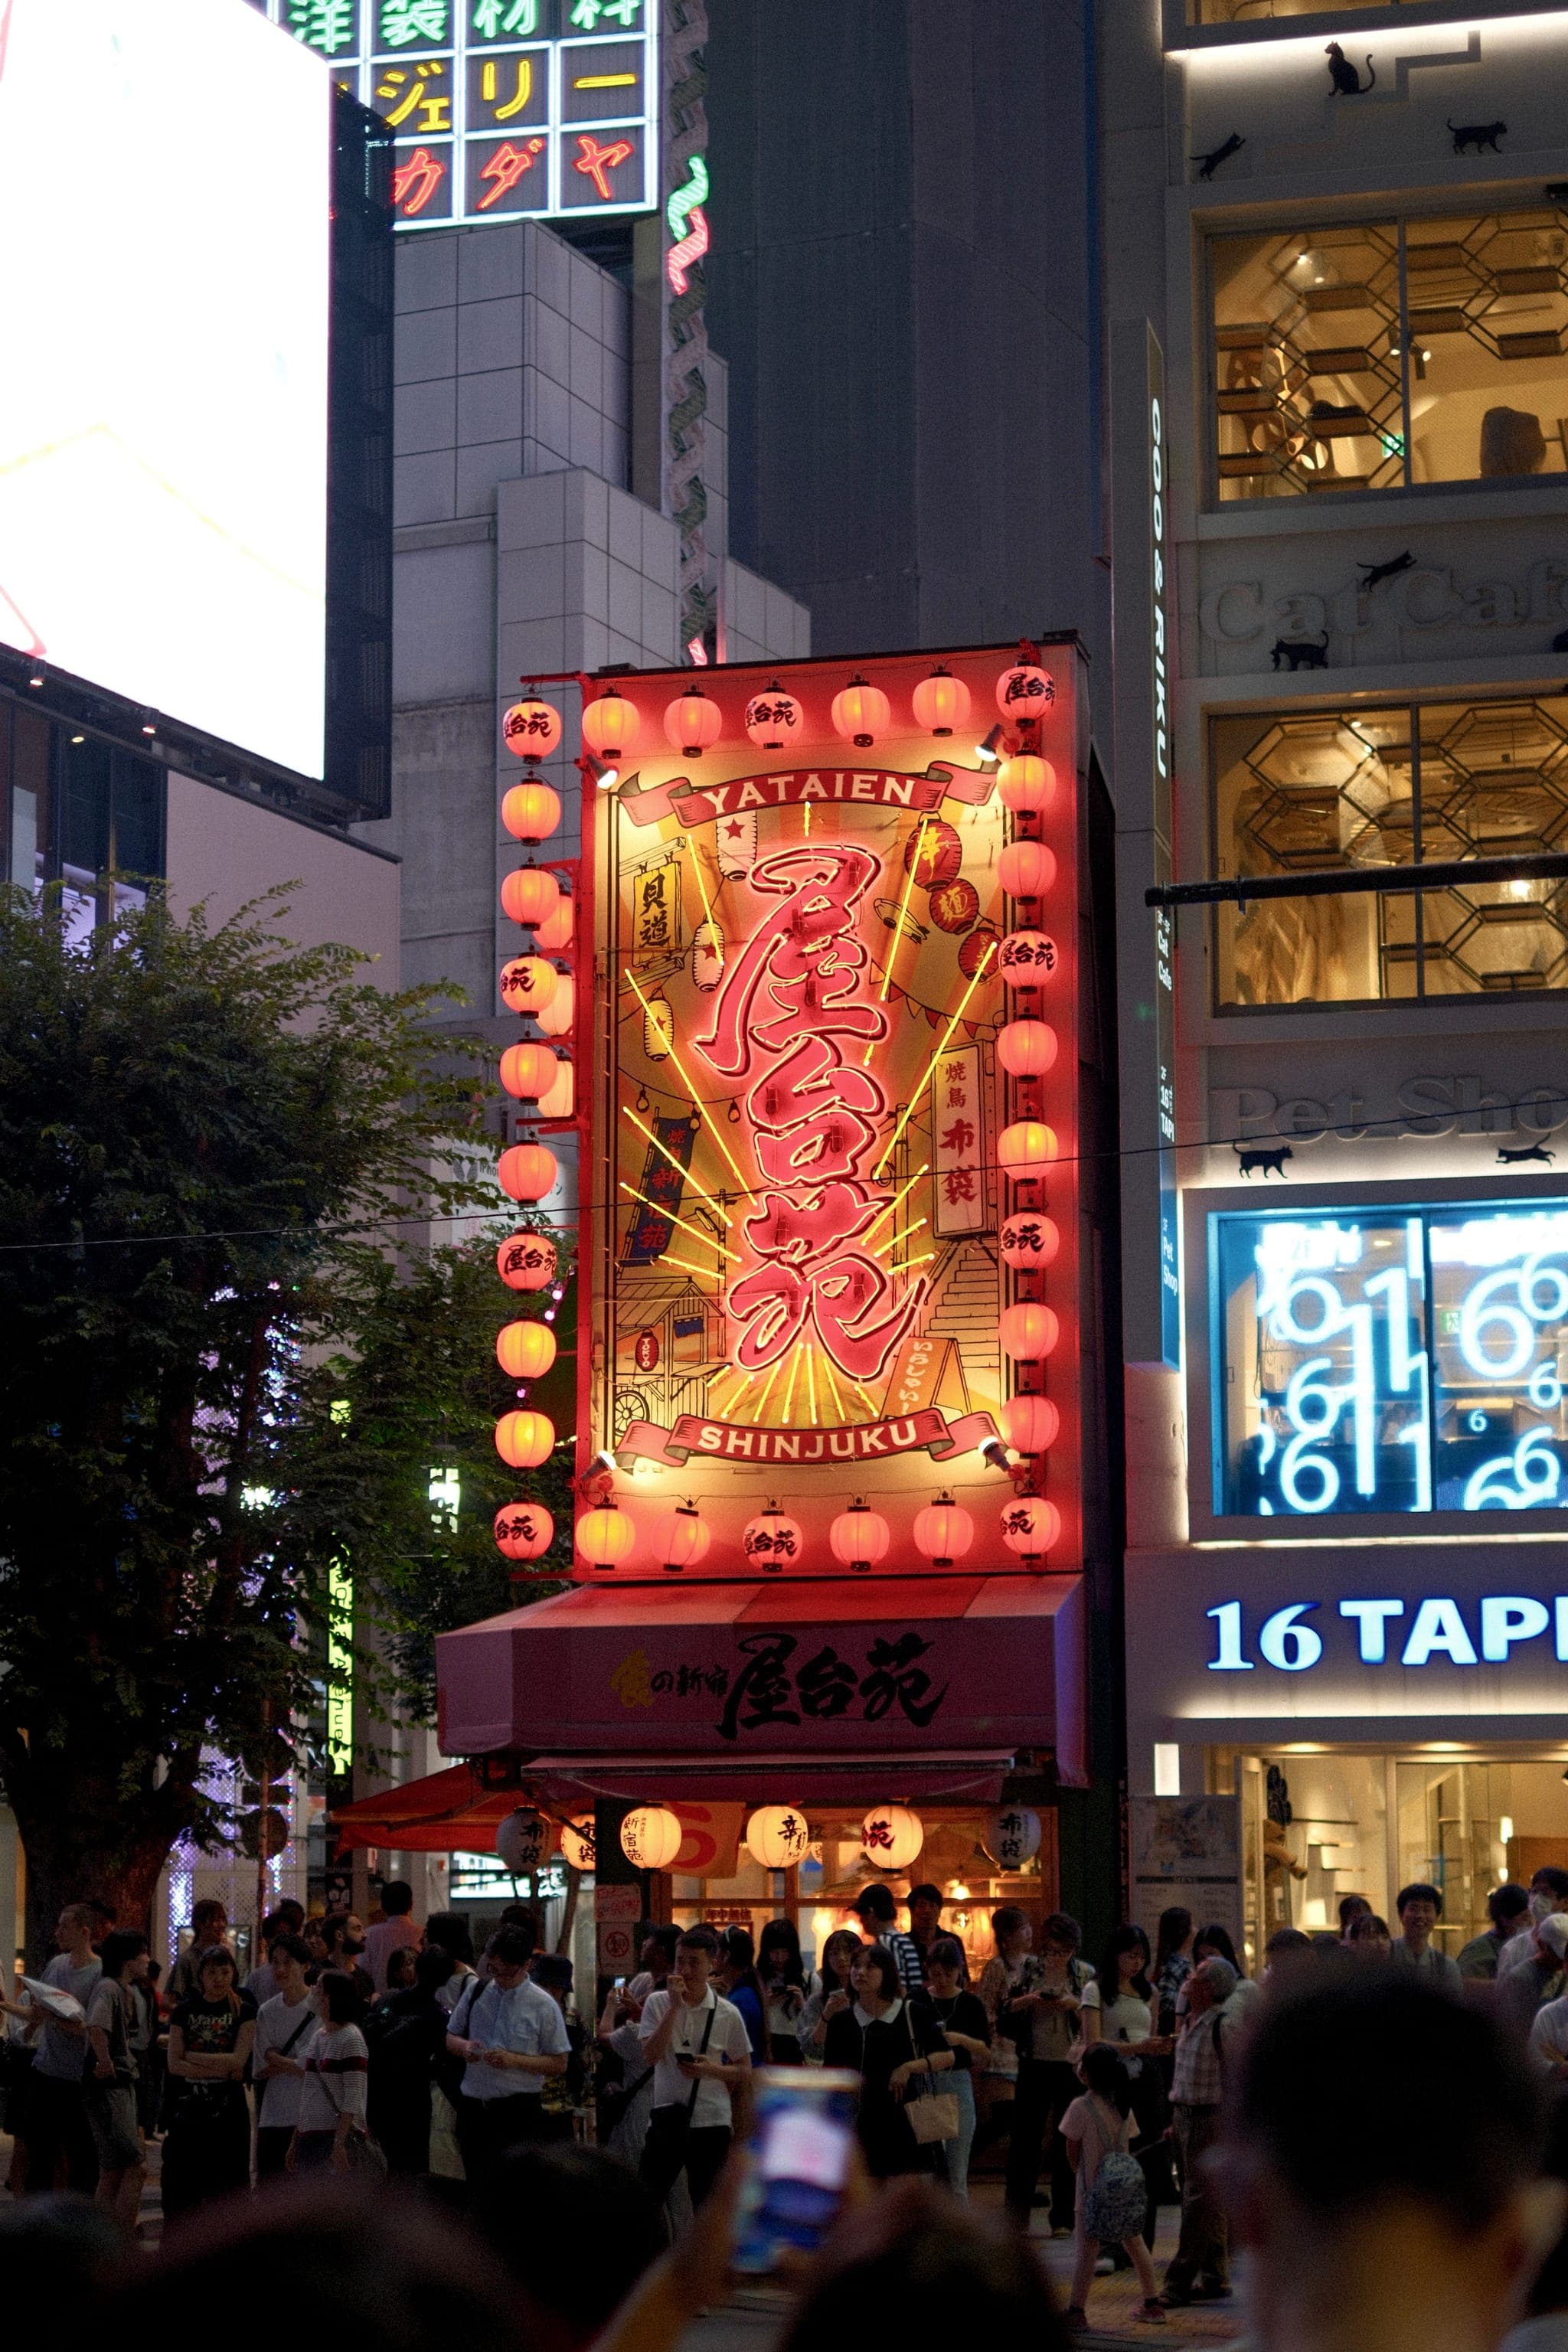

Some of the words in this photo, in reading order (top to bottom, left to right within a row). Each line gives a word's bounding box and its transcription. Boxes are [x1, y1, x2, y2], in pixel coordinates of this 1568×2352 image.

[1155, 604, 1166, 779] RIKU
[701, 773, 916, 815] YATAIEN
[1210, 1088, 1367, 1148] Pet
[642, 1338, 651, 1367] TOKYO
[697, 1419, 918, 1459] SHINJUKU
[1206, 1600, 1322, 1671] 16
[714, 1632, 949, 1740] 屋台苑
